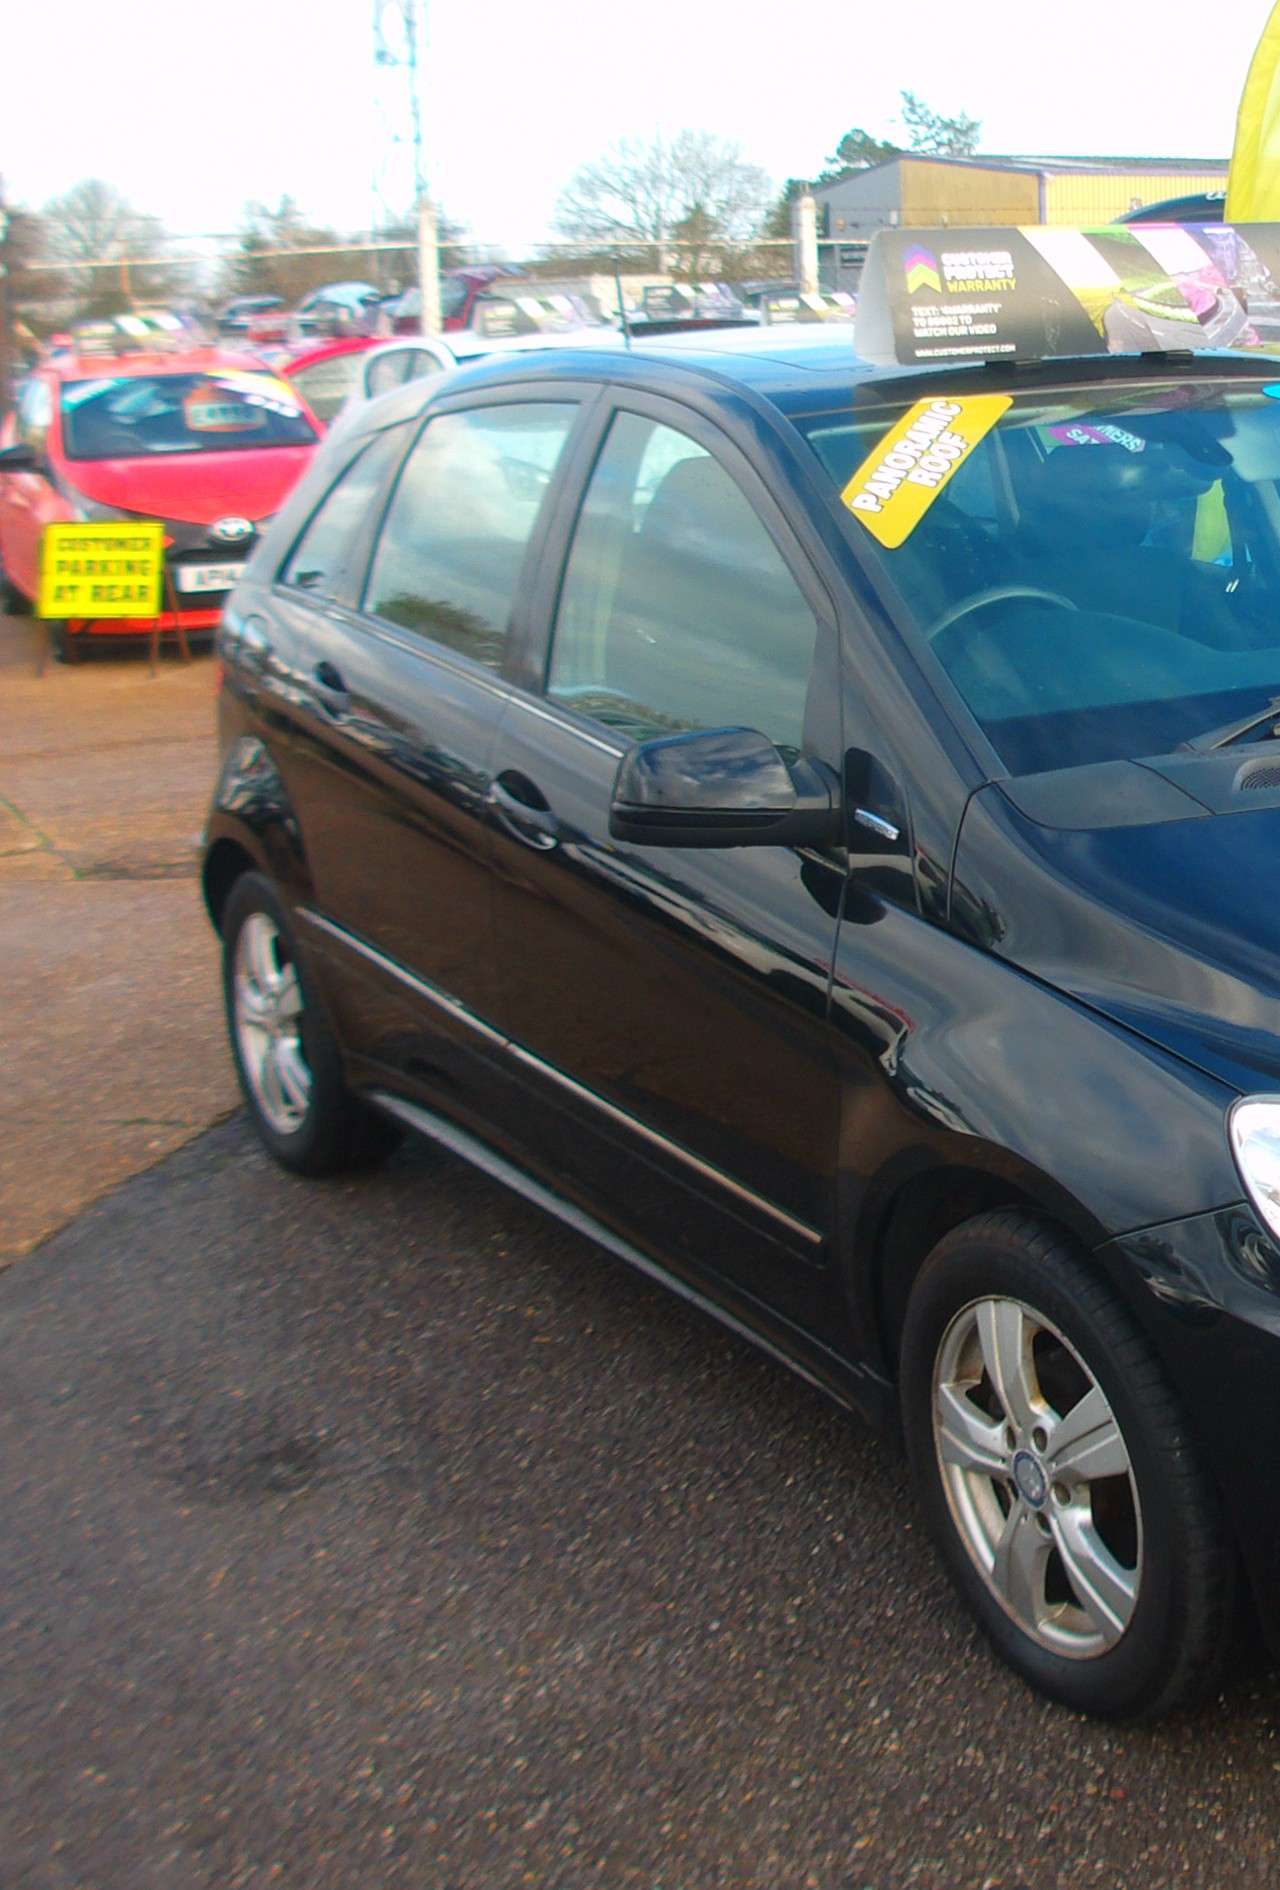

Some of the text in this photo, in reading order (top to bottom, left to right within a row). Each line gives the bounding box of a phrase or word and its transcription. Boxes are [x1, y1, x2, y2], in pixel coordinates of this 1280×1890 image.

[941, 251, 1012, 266] CUSTOMER
[943, 264, 1014, 280] PROTECT
[946, 278, 1016, 293] WARRANTY
[851, 401, 962, 513] PANORAMIC
[907, 432, 968, 488] ROOF
[56, 537, 150, 551] CUSTOMER
[55, 559, 150, 577] PARKING
[53, 584, 149, 602] AT REAR
